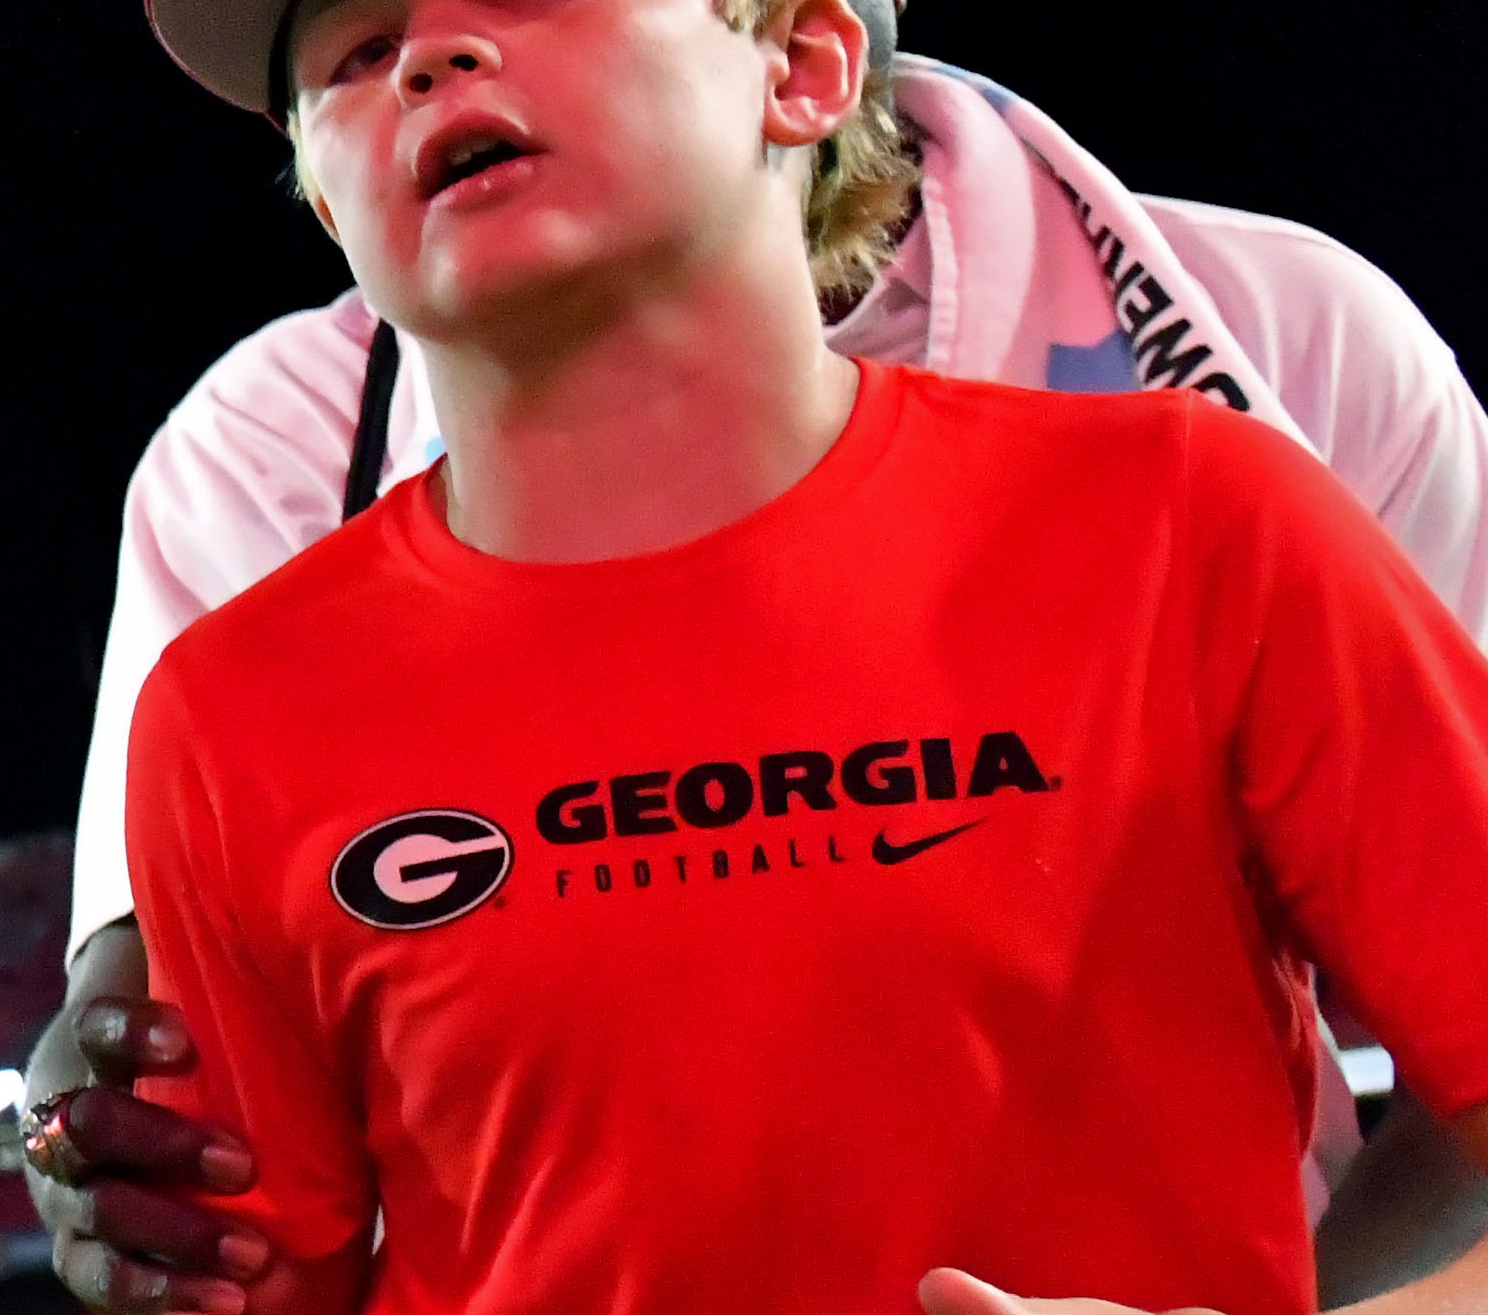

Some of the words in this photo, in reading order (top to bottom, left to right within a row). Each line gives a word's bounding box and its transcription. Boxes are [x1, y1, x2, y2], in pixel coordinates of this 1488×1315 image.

[535, 730, 1049, 846] GEORGIA
[334, 812, 511, 927] G
[554, 835, 848, 899] FOOTBALL
